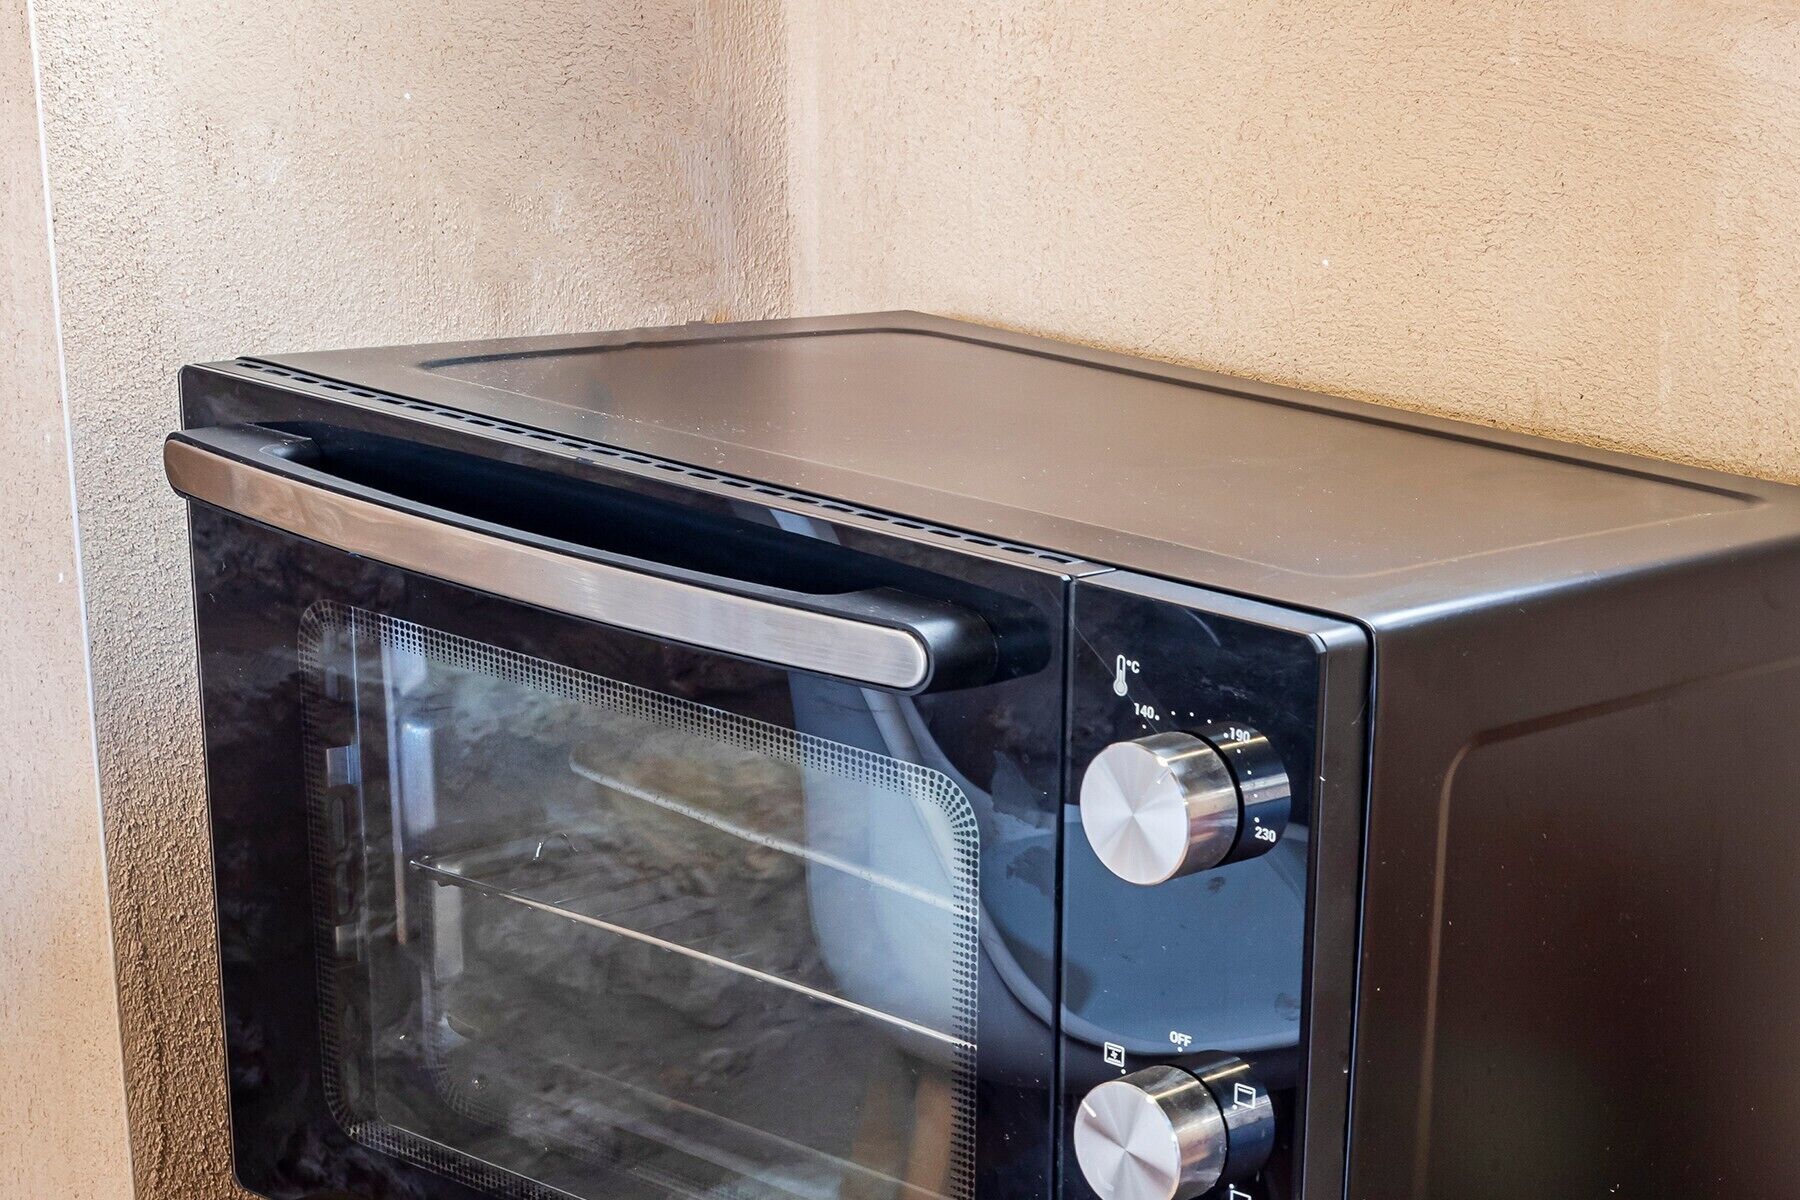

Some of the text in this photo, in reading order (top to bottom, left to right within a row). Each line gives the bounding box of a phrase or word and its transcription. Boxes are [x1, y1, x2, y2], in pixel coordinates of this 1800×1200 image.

[1134, 702, 1154, 718] 140
[1229, 727, 1250, 743] 190
[1255, 826, 1276, 843] 230
[1169, 1030, 1192, 1047] OFF
